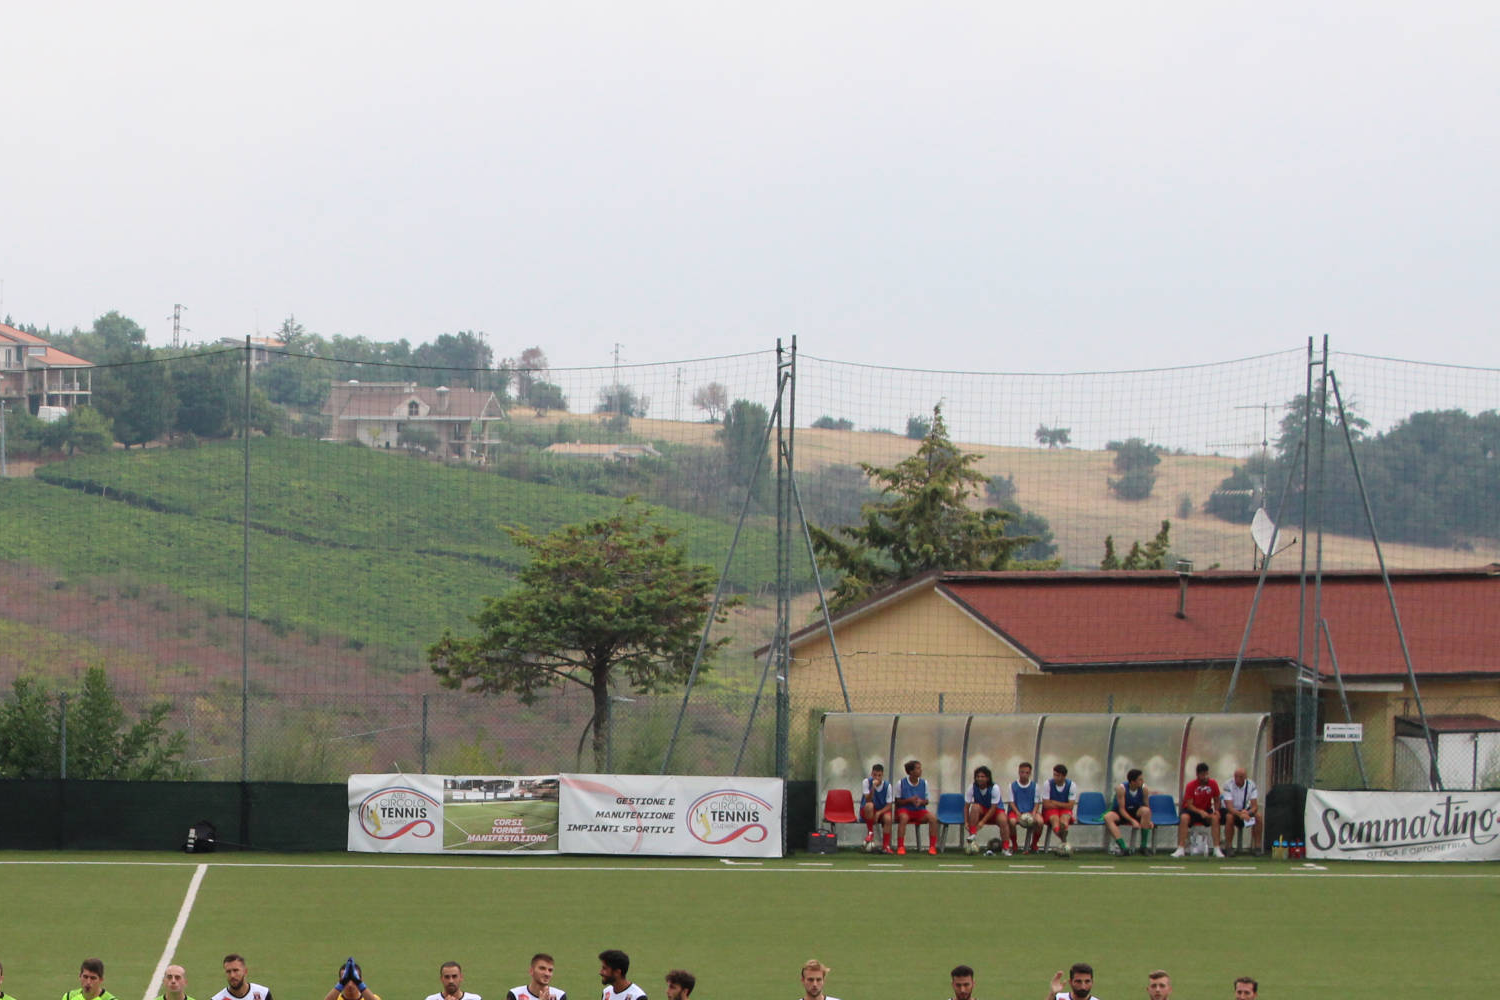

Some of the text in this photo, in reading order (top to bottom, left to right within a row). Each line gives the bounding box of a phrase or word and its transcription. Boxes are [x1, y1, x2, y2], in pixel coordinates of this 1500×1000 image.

[380, 798, 426, 808] CIRCOLO
[616, 797, 676, 806] GESTIONE E
[709, 801, 758, 811] CIRCOLO
[381, 807, 427, 819] TENNIS
[595, 811, 676, 820] MANUTENZIONE
[710, 811, 760, 822] TENNIS
[1309, 796, 1499, 851] Sammartino
[566, 824, 676, 834] IMPIANTI SPORTIVI
[467, 834, 549, 842] MANIFESTAZIONI
[1366, 842, 1468, 858] OTTICA E OPTOMETRIA
